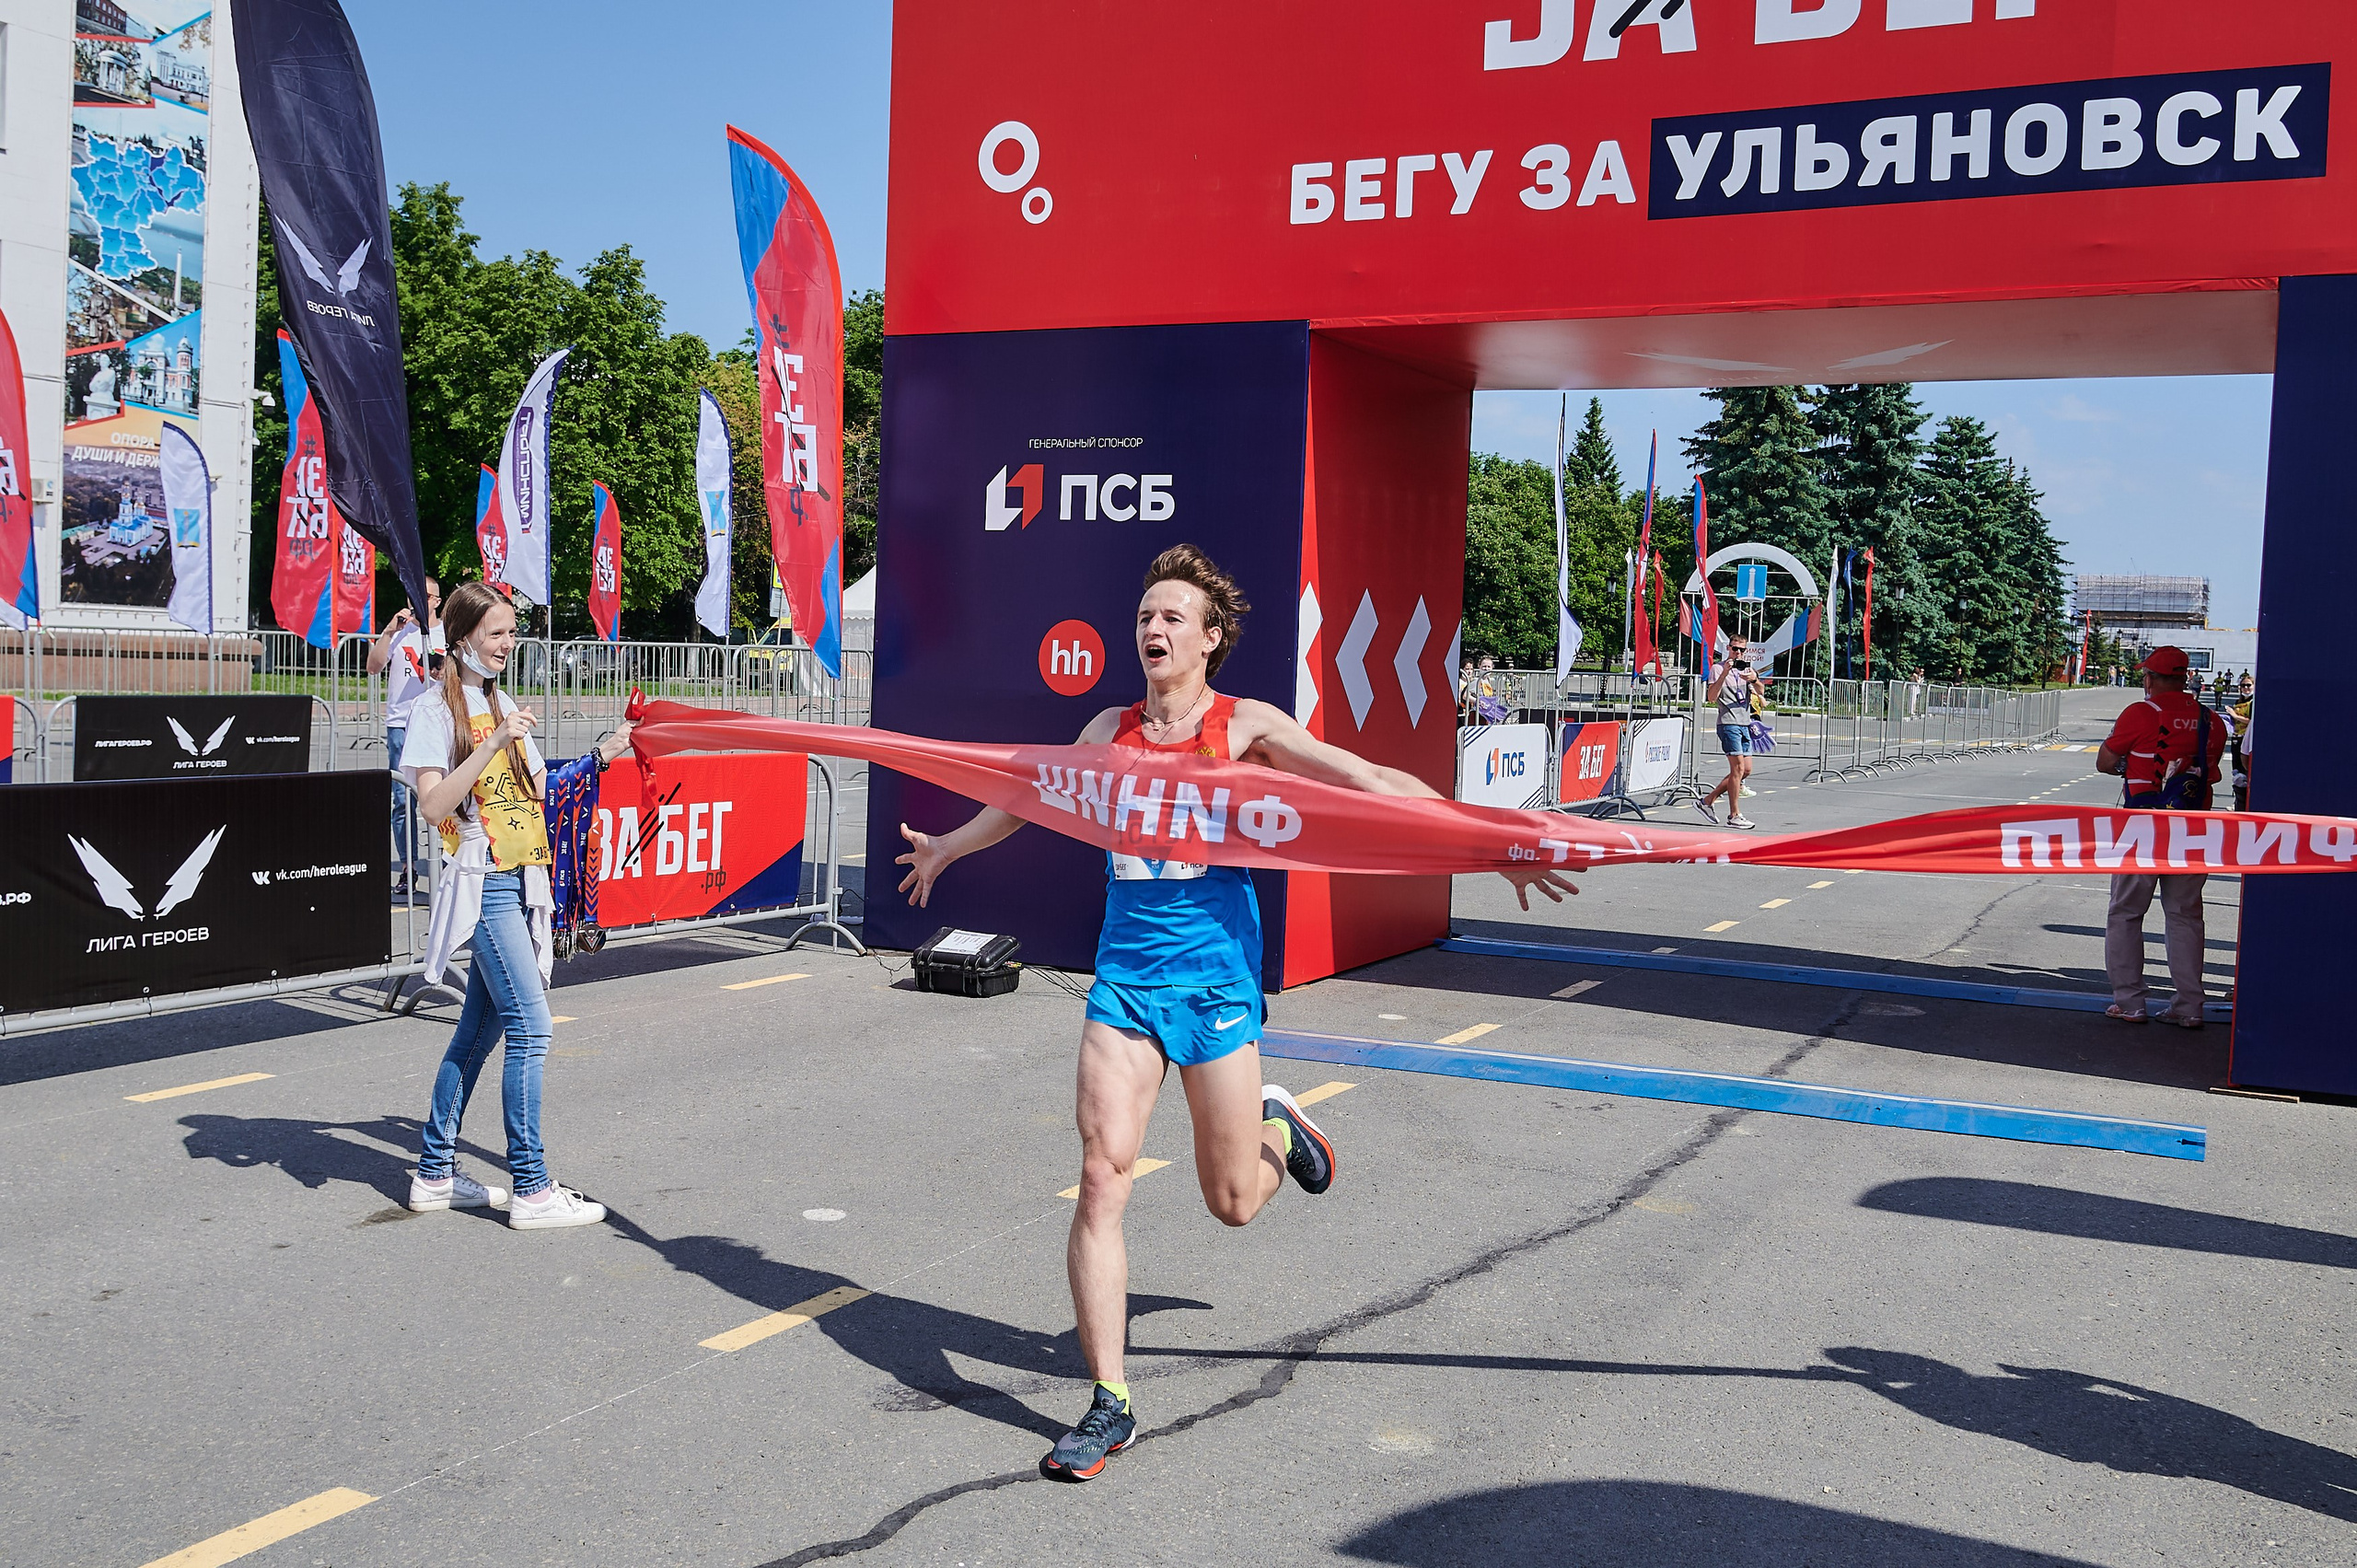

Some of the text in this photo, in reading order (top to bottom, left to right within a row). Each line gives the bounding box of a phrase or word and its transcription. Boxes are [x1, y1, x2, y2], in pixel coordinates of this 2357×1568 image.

[1289, 84, 2303, 226] БЕГУ ЗА УЛЬЯНОВСК
[110, 432, 156, 449] ОПОРА
[1028, 436, 1144, 449] ГЕНЕРАЛЬНЫЙ СПОНСОР
[72, 446, 111, 462] ДУШИ
[115, 450, 124, 464] И
[1060, 473, 1175, 522] ПСБ
[1051, 639, 1094, 677] hh
[173, 760, 227, 769] ЛИГА ГЕРОЕВ
[1502, 751, 1526, 778] ПСБ
[1578, 745, 1590, 780] ЗА
[1590, 744, 1606, 779] БЕГ
[656, 801, 733, 876] БЕГ
[2001, 815, 2357, 867] ФИНИШ
[275, 863, 367, 881] vk.com/heroleague
[701, 865, 727, 895] .рф
[87, 927, 210, 953] ЛИГА ГЕРОЕВ
